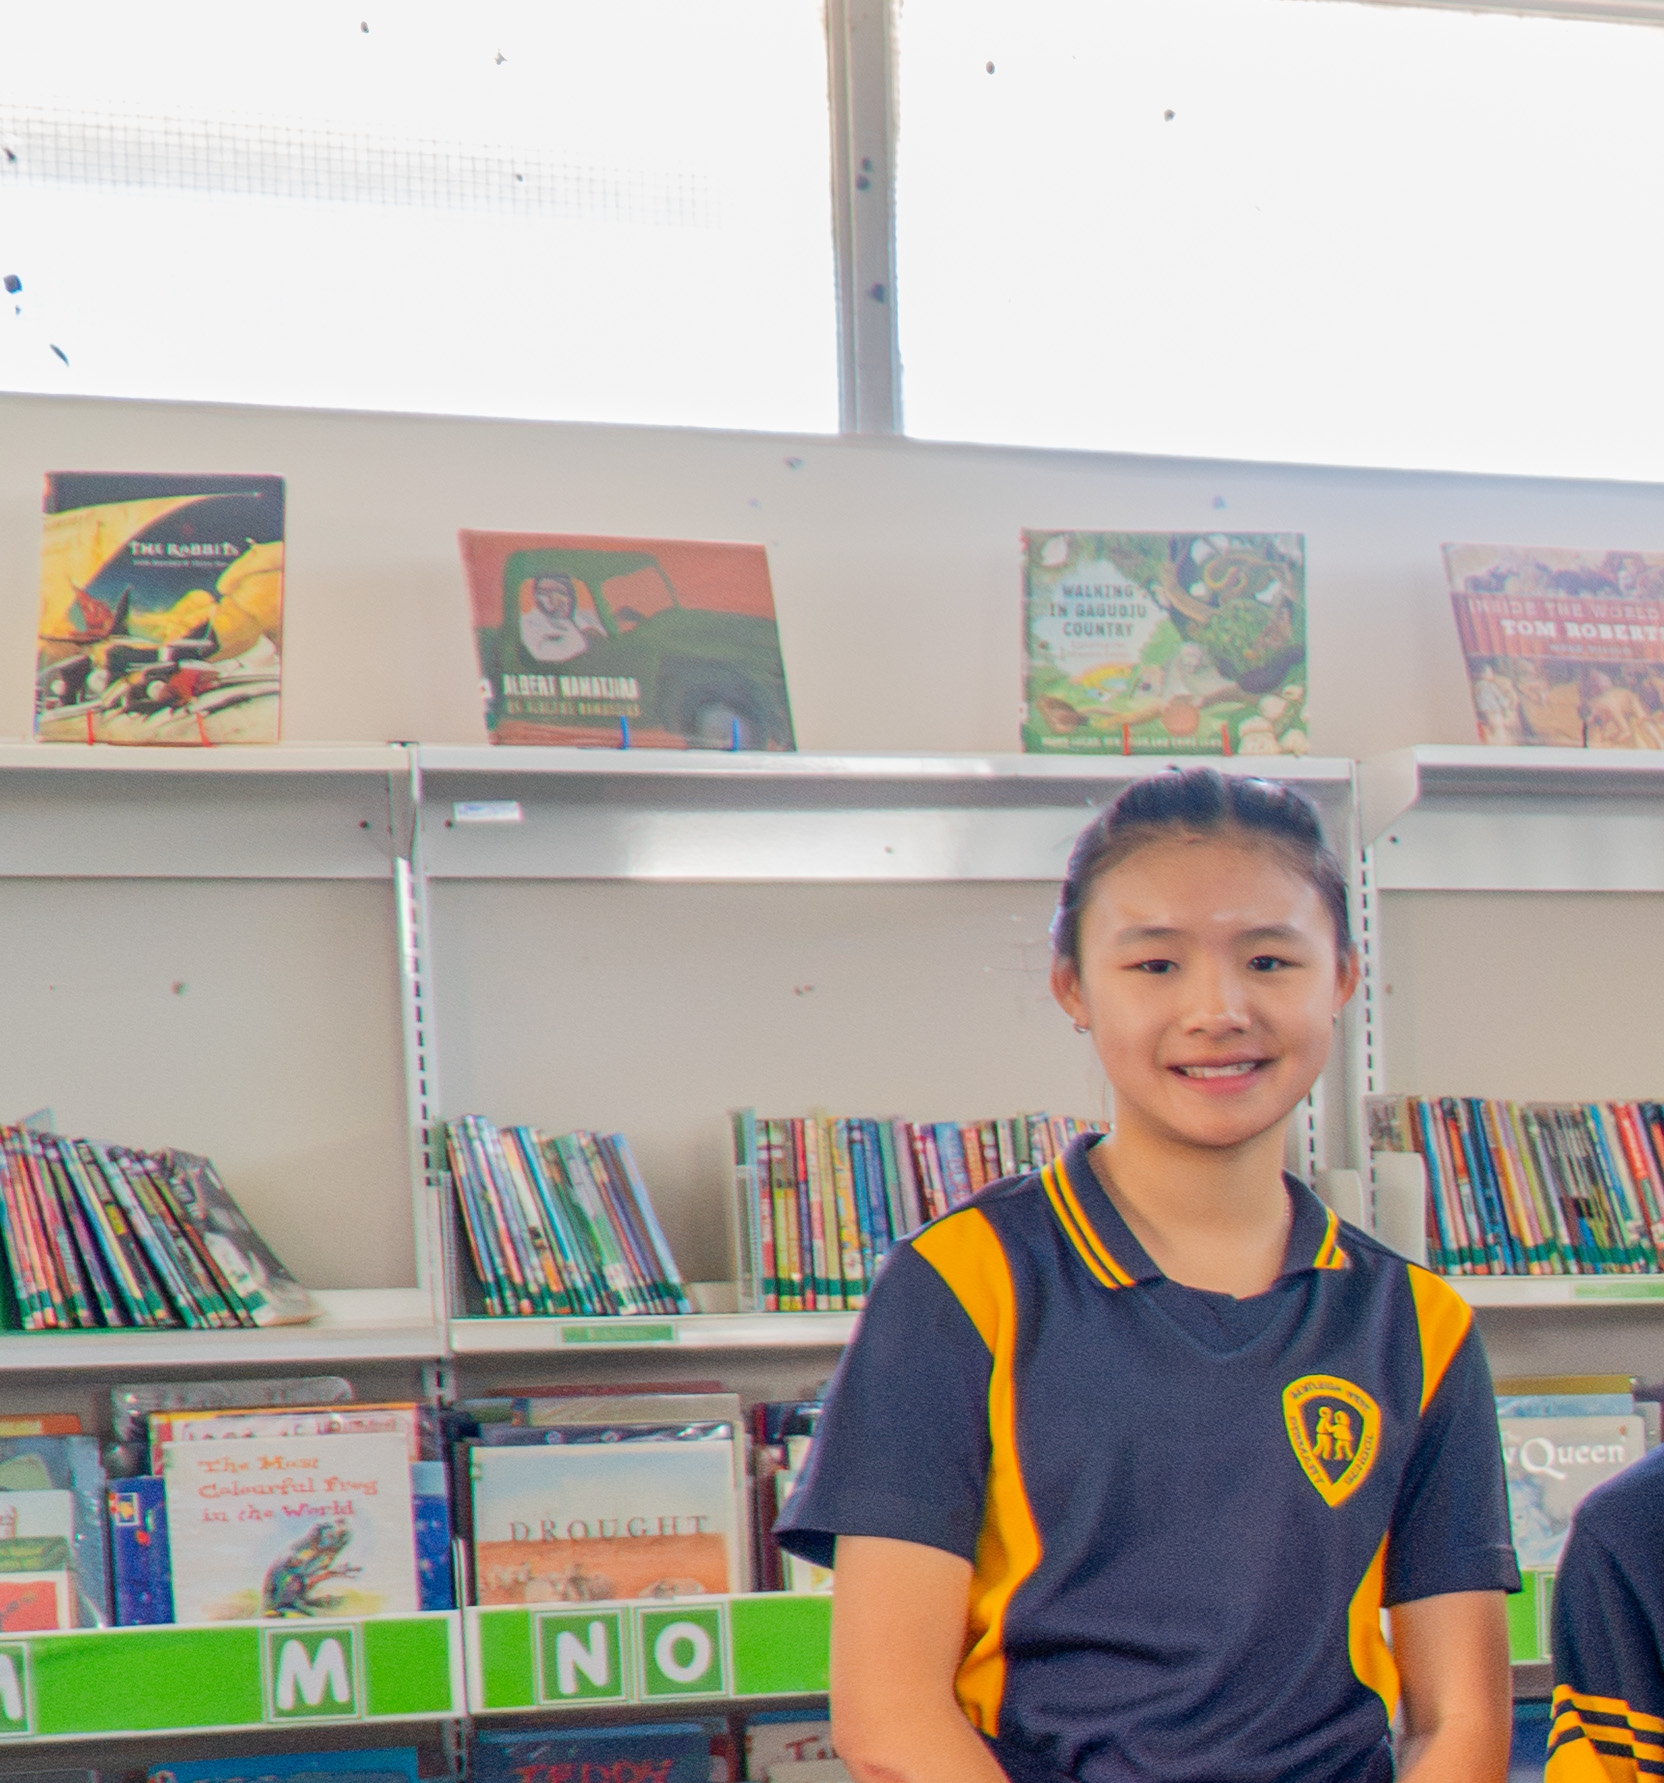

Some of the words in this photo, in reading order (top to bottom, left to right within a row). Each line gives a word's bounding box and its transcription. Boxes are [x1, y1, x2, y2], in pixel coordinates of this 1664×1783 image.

[1061, 583, 1137, 600] WALKING
[1049, 603, 1067, 619] IN
[1062, 621, 1135, 638] COUNTRY
[1500, 619, 1557, 637] TOM
[198, 1456, 250, 1474] The
[1520, 1437, 1625, 1480] Queen
[198, 1477, 314, 1499] Colourful
[323, 1477, 378, 1496] Frog
[202, 1508, 228, 1523] in
[238, 1506, 274, 1522] the
[281, 1500, 355, 1518] World
[508, 1513, 710, 1543] DROUGHT
[556, 1620, 610, 1695] N
[654, 1621, 712, 1683] O
[277, 1637, 351, 1711] M
